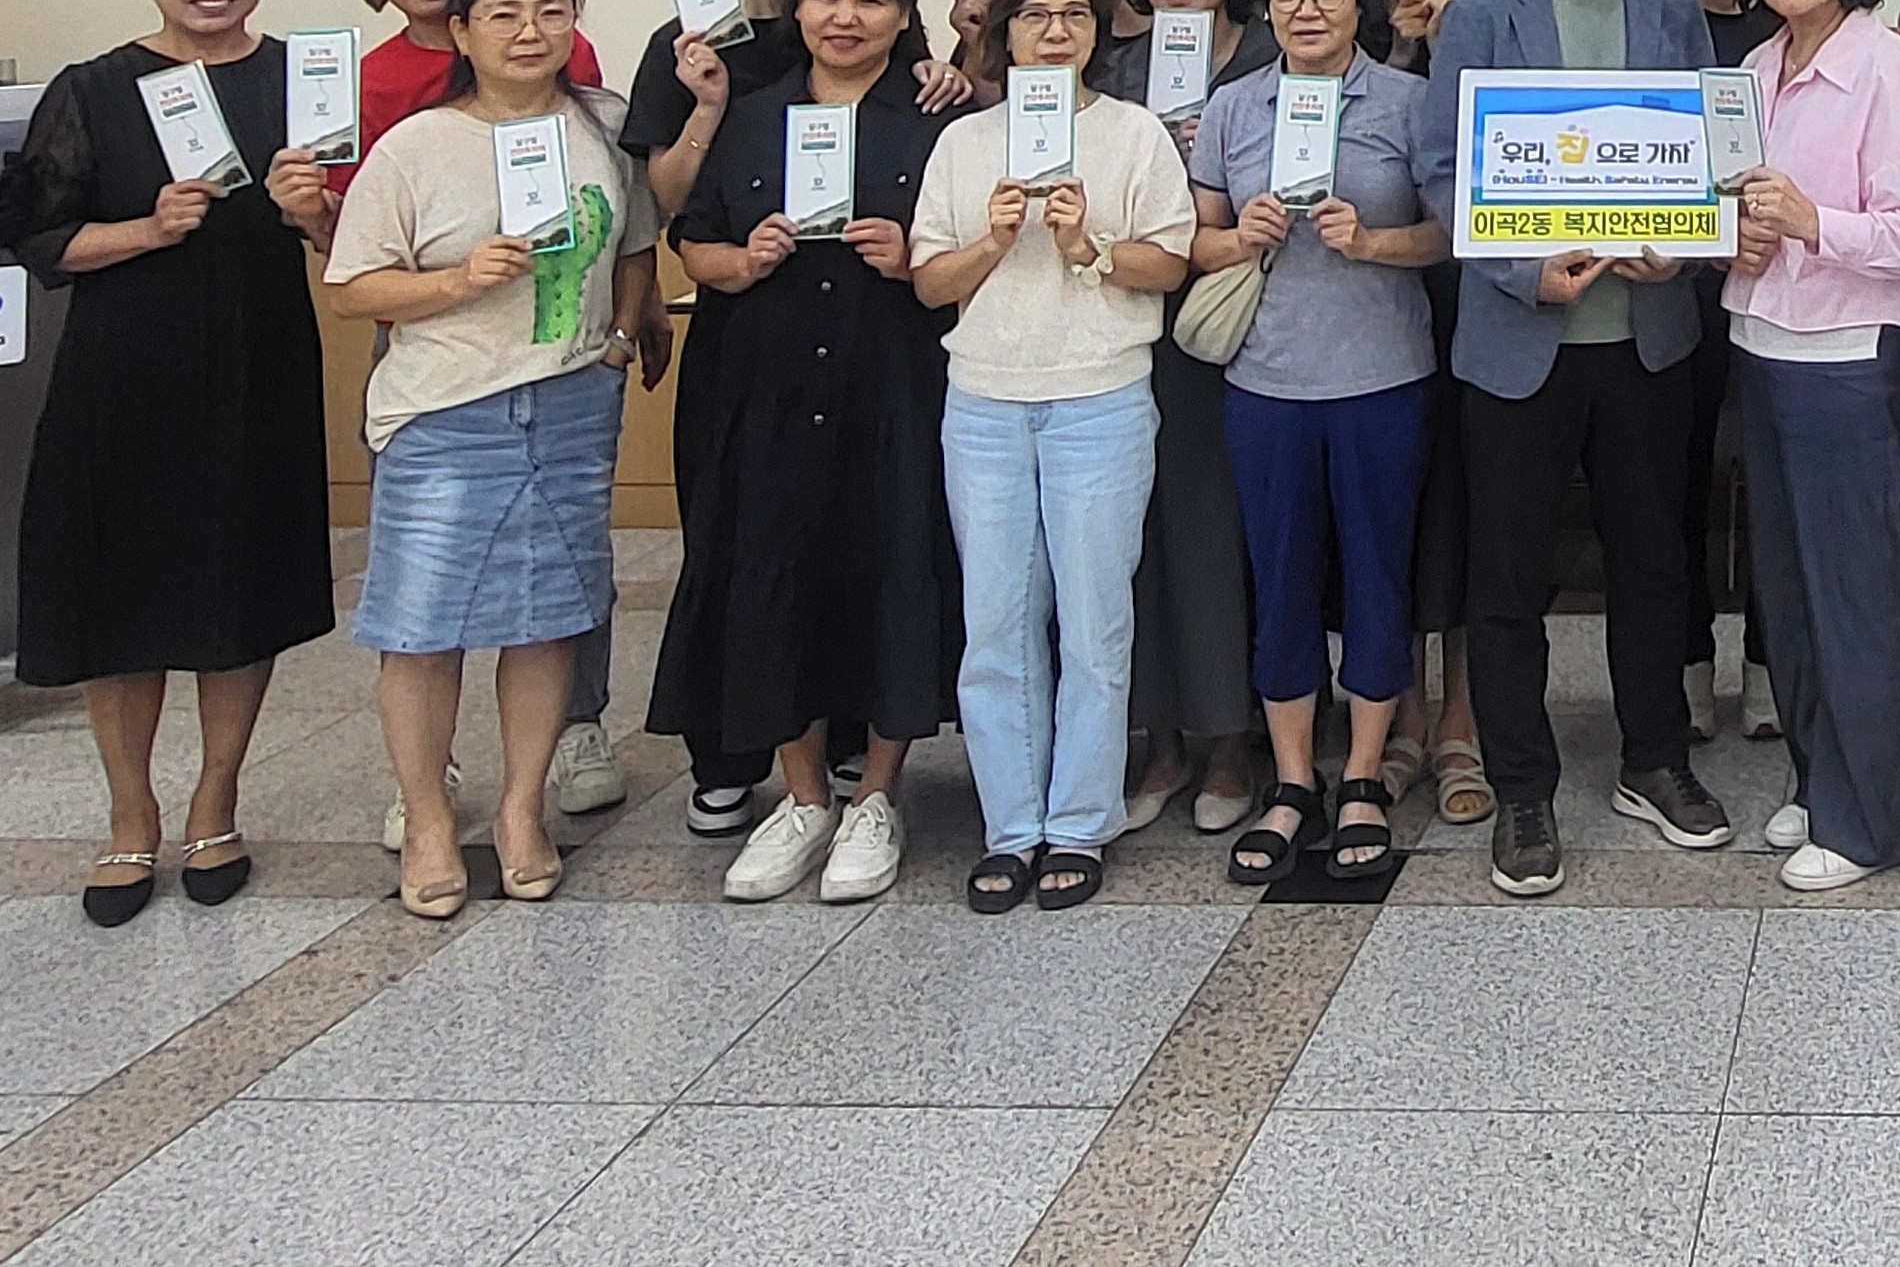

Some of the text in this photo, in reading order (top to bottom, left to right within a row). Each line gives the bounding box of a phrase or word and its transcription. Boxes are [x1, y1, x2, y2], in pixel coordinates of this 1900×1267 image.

[1596, 142, 1640, 164] 으로
[1475, 211, 1717, 236] 이곡2동 복지안전협의체
